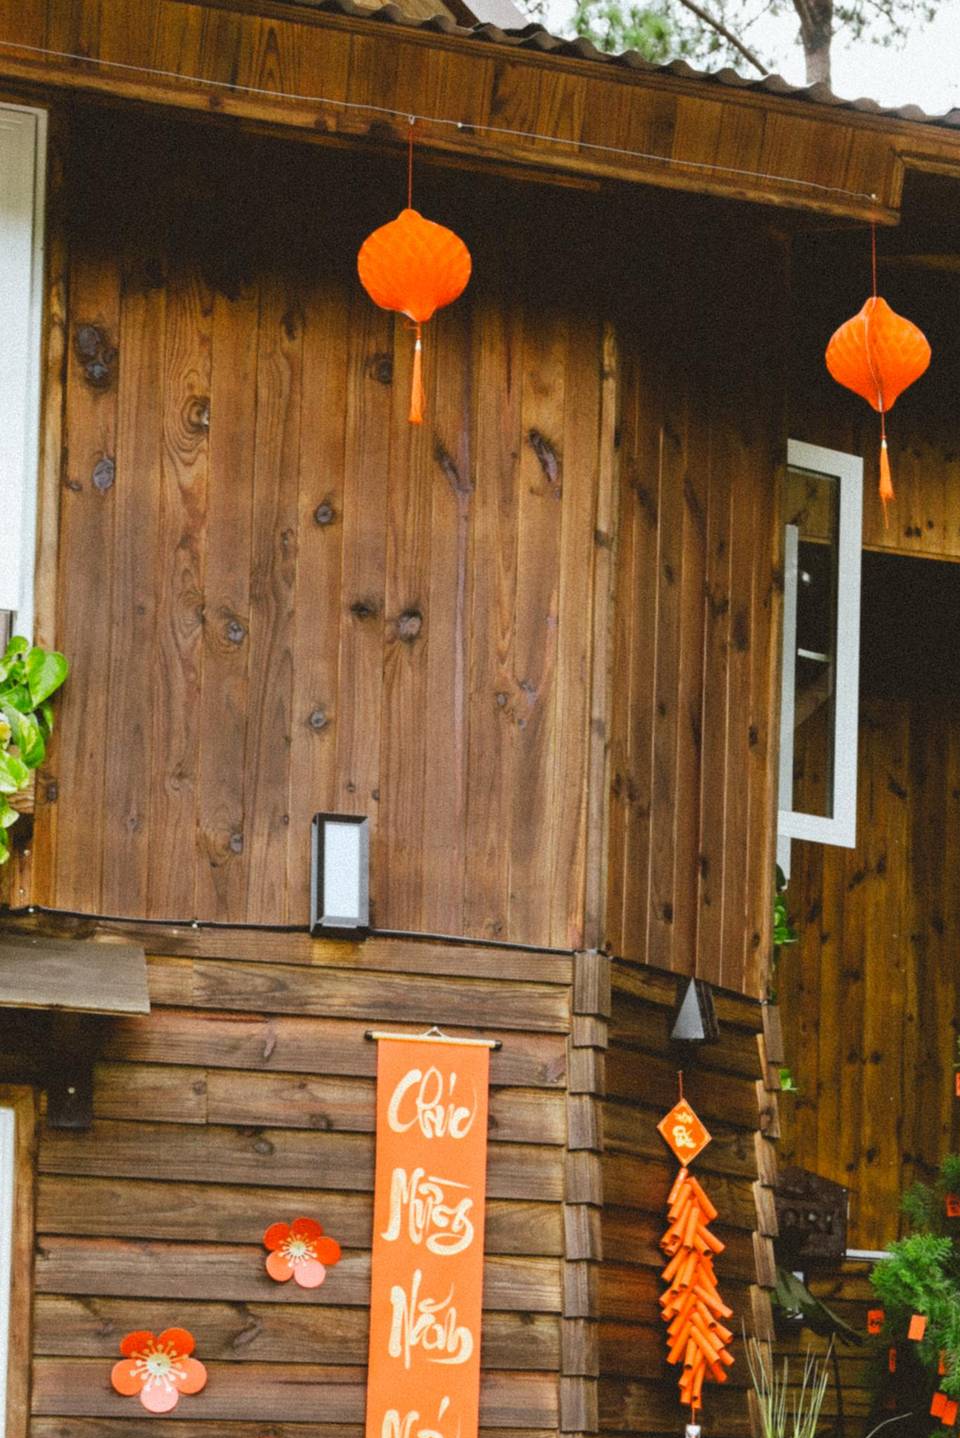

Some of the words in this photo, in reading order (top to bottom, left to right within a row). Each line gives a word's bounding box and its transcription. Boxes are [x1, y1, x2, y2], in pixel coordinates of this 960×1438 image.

[387, 1066, 477, 1140] Chúc
[380, 1167, 475, 1257] Mừng
[388, 1269, 475, 1370] Năm
